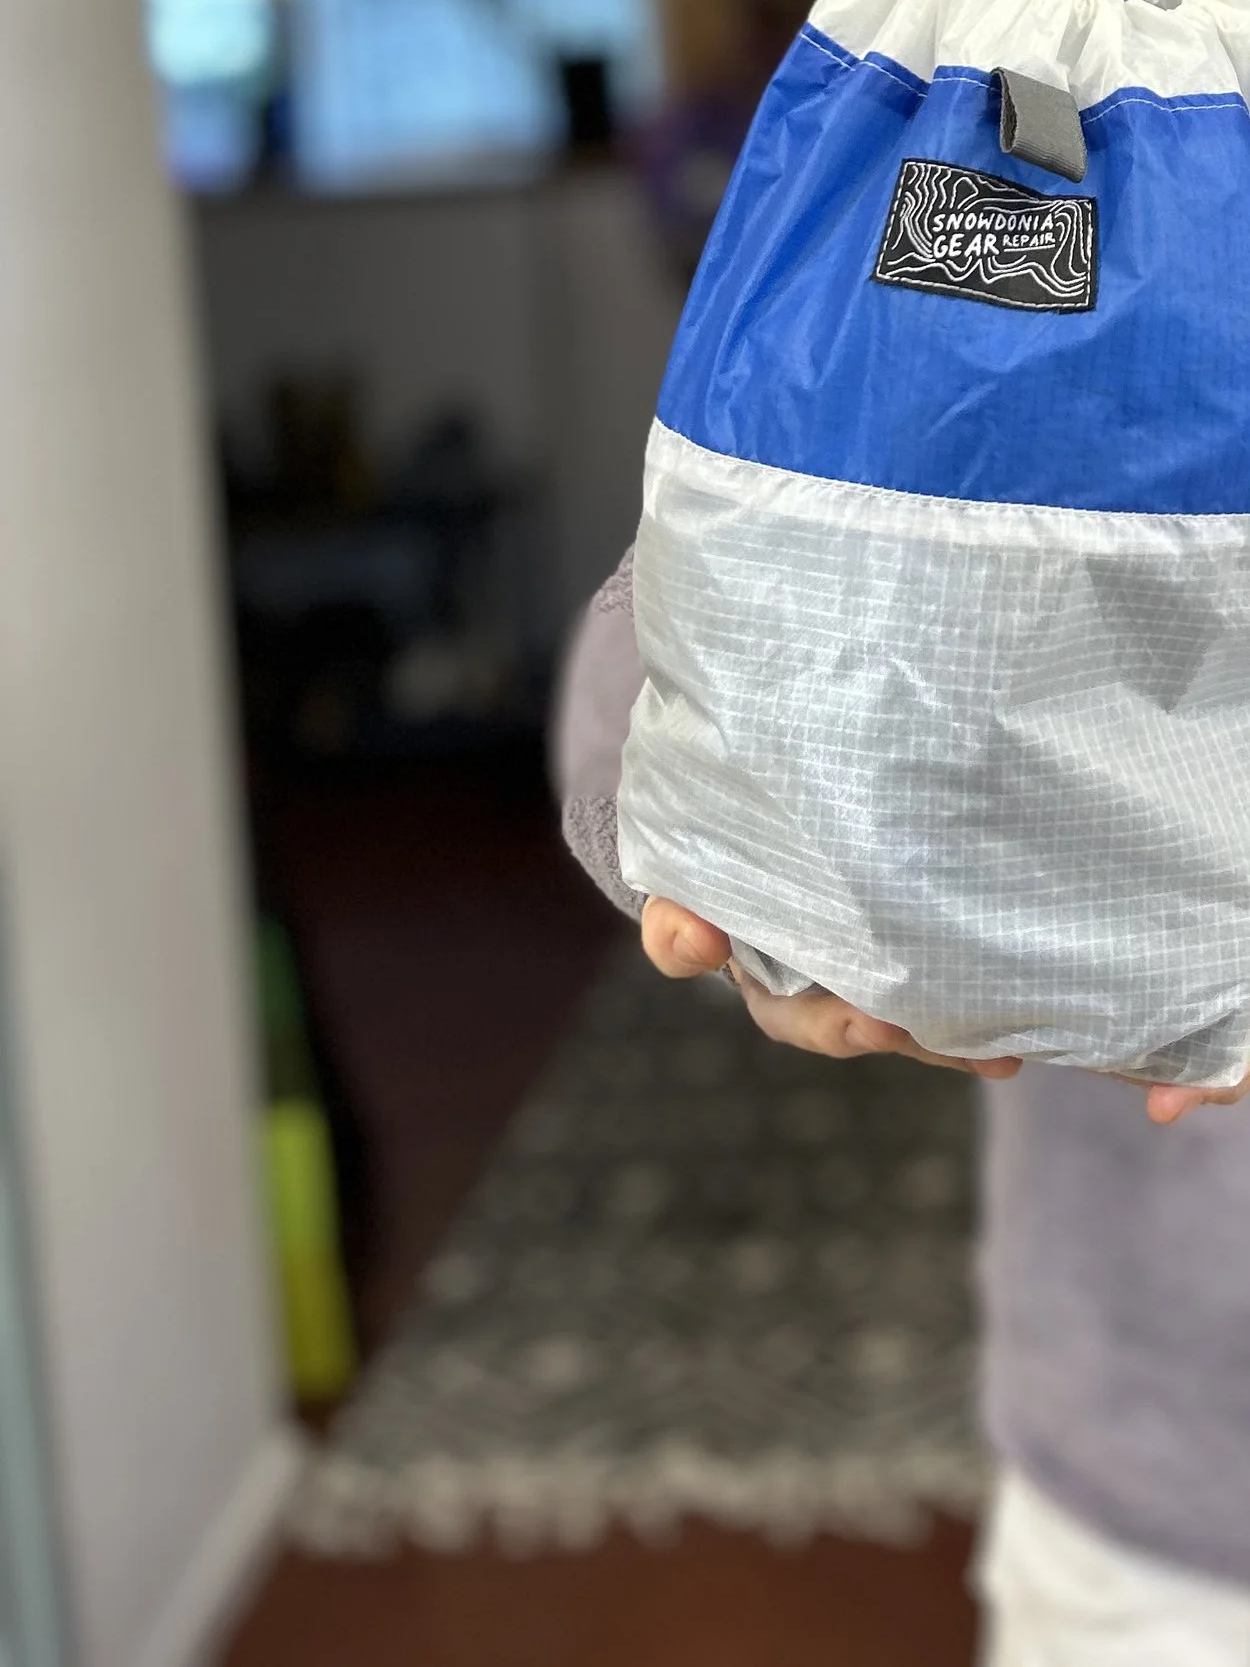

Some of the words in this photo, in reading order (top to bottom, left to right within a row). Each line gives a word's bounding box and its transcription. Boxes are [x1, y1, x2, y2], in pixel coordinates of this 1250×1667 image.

[932, 212, 1054, 232] SNOWDONIA
[933, 233, 1000, 258] GEAR
[1002, 232, 1055, 246] REPAIR
